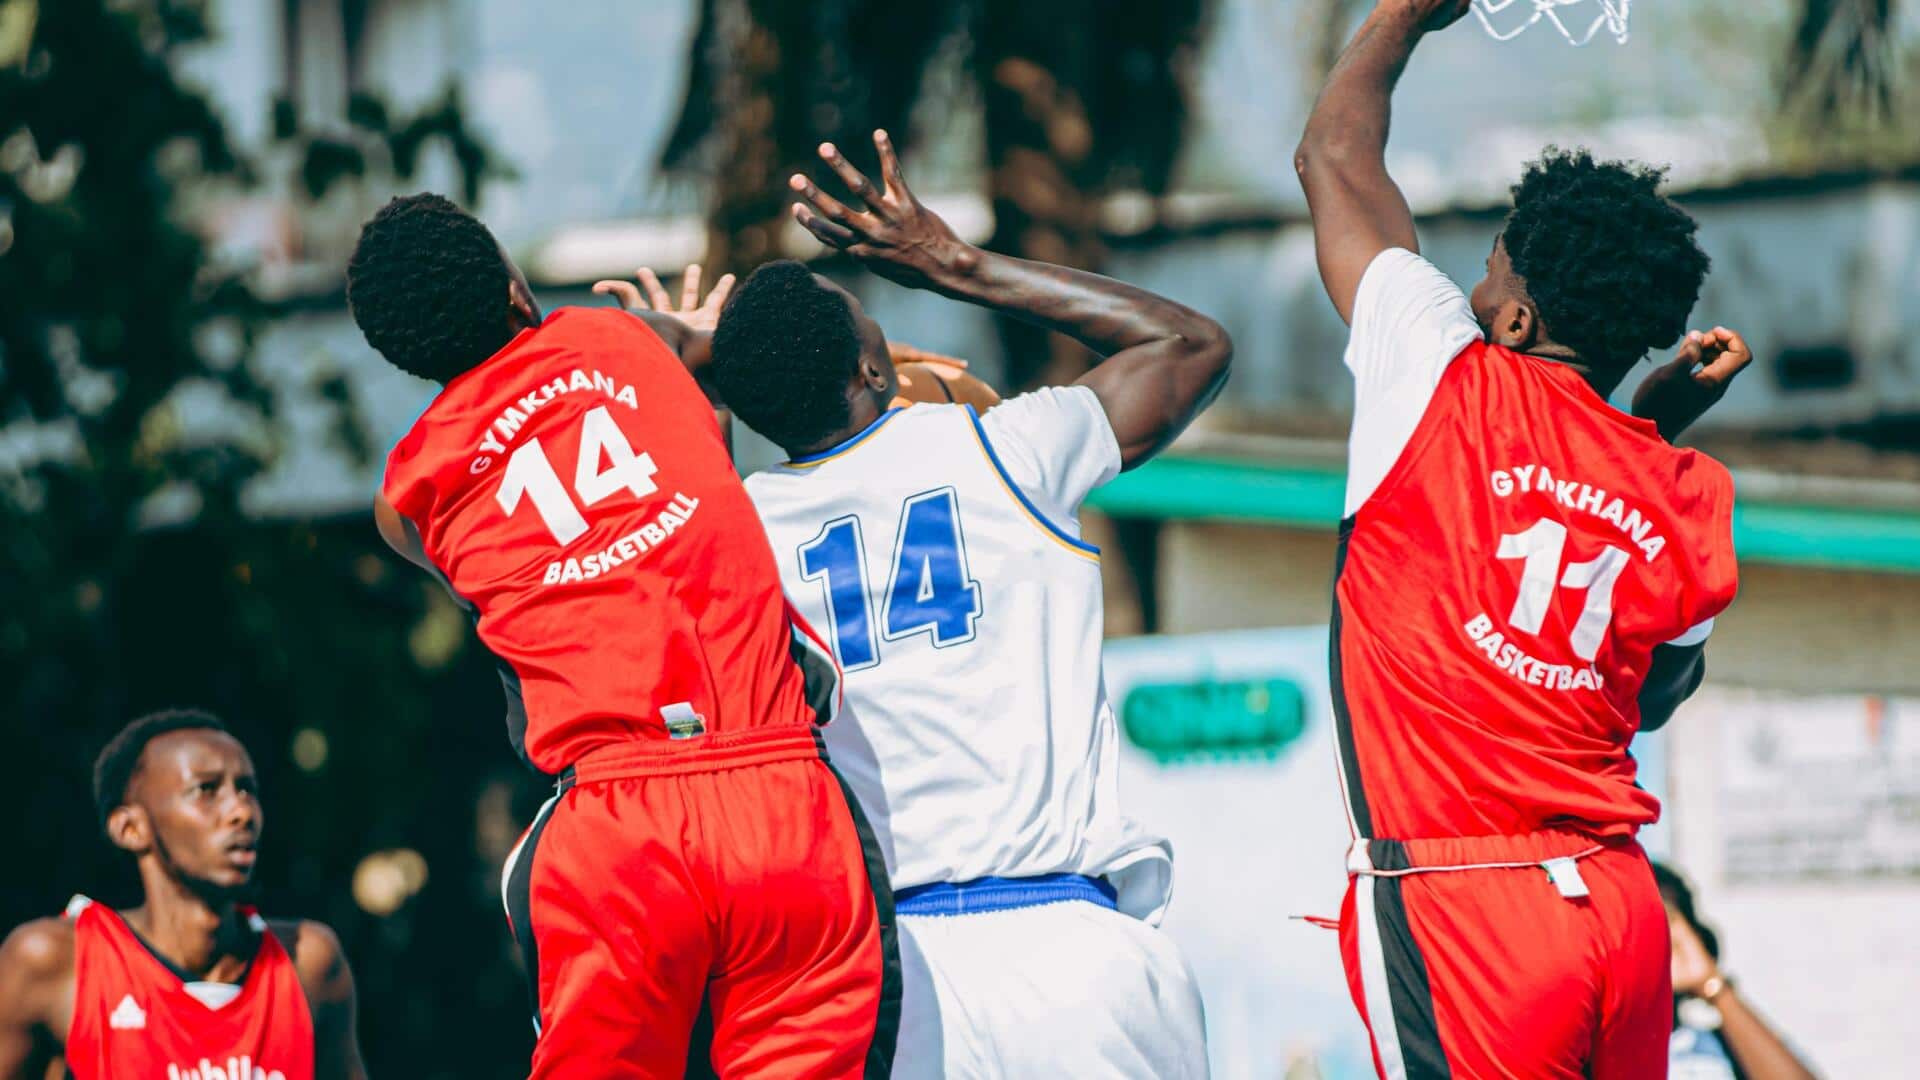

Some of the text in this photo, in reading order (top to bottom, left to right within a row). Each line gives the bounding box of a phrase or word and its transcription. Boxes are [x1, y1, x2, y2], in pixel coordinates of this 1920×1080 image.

[470, 369, 638, 475] GYMKHANA
[495, 405, 659, 547] 14
[542, 492, 700, 585] BASKETBALL
[797, 485, 984, 674] 14
[1496, 517, 1631, 662] 11
[1464, 612, 1604, 691] BASKETBA
